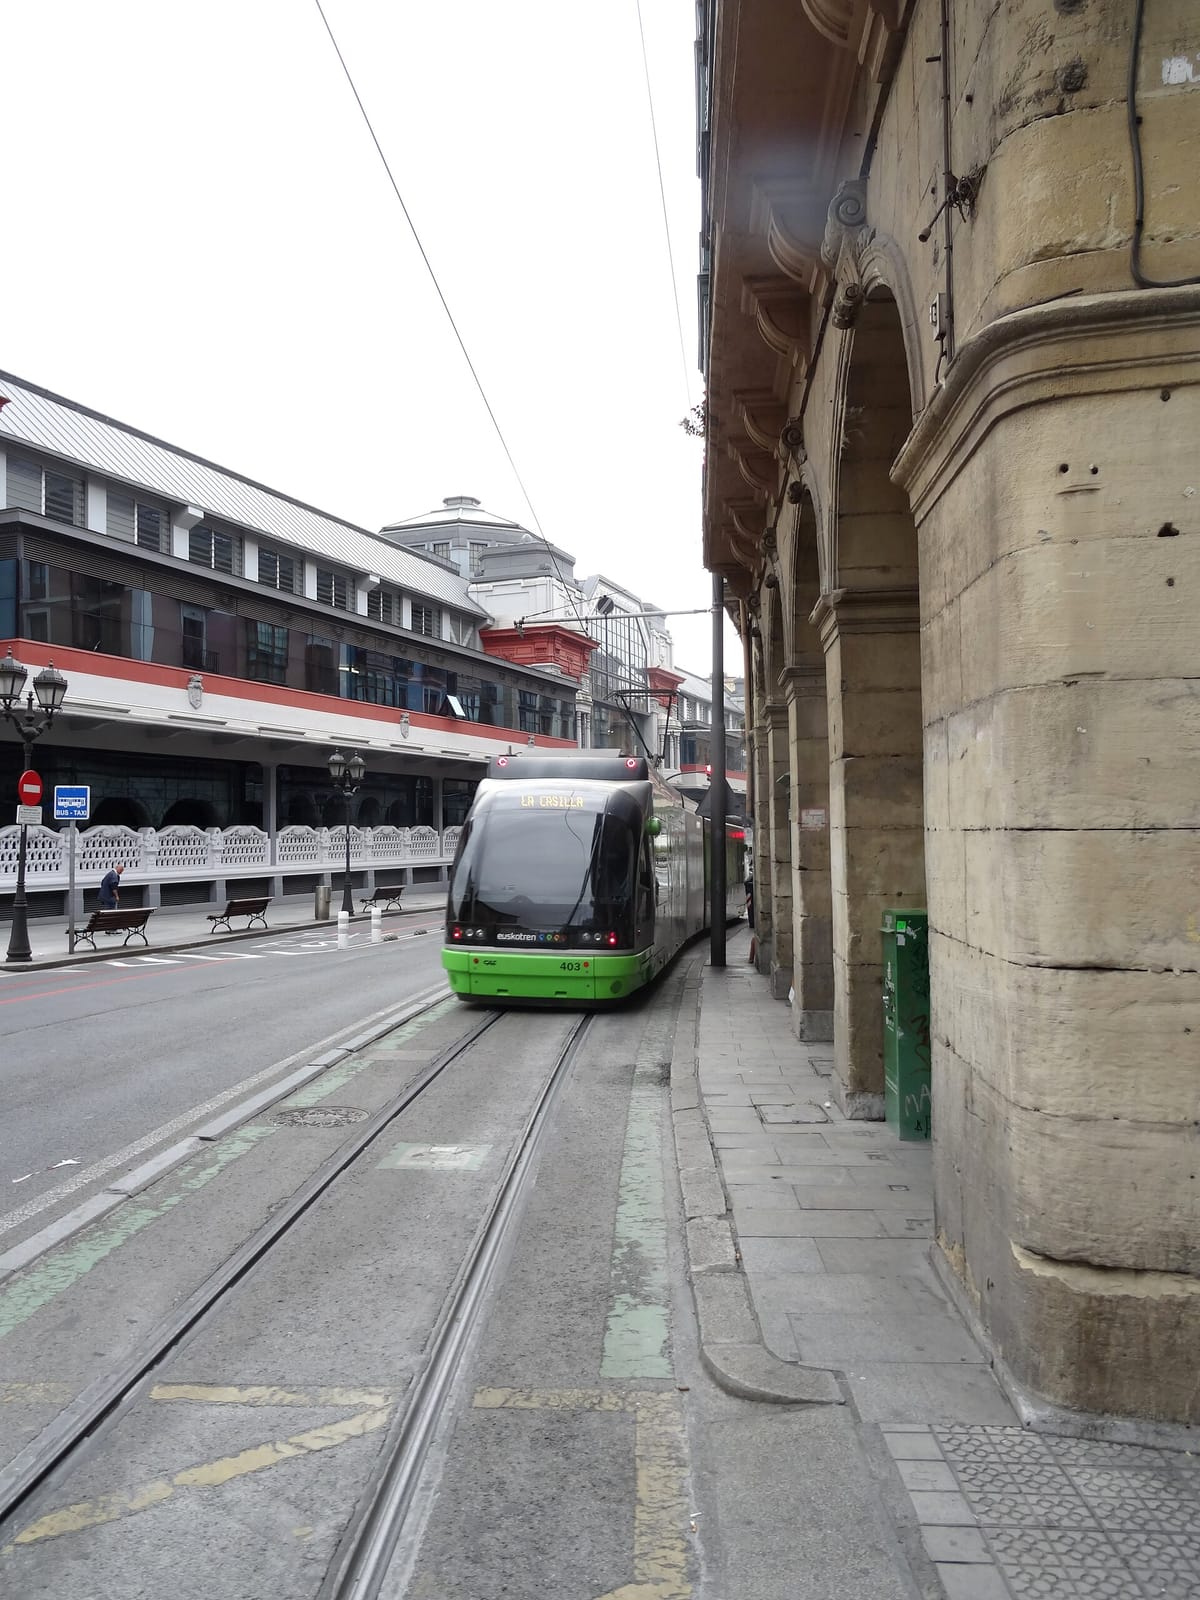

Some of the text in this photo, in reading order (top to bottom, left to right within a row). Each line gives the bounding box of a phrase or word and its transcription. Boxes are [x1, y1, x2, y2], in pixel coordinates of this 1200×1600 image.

[521, 795, 583, 808] LA CASILLA
[496, 932, 537, 942] euskotren
[559, 961, 581, 971] 403
